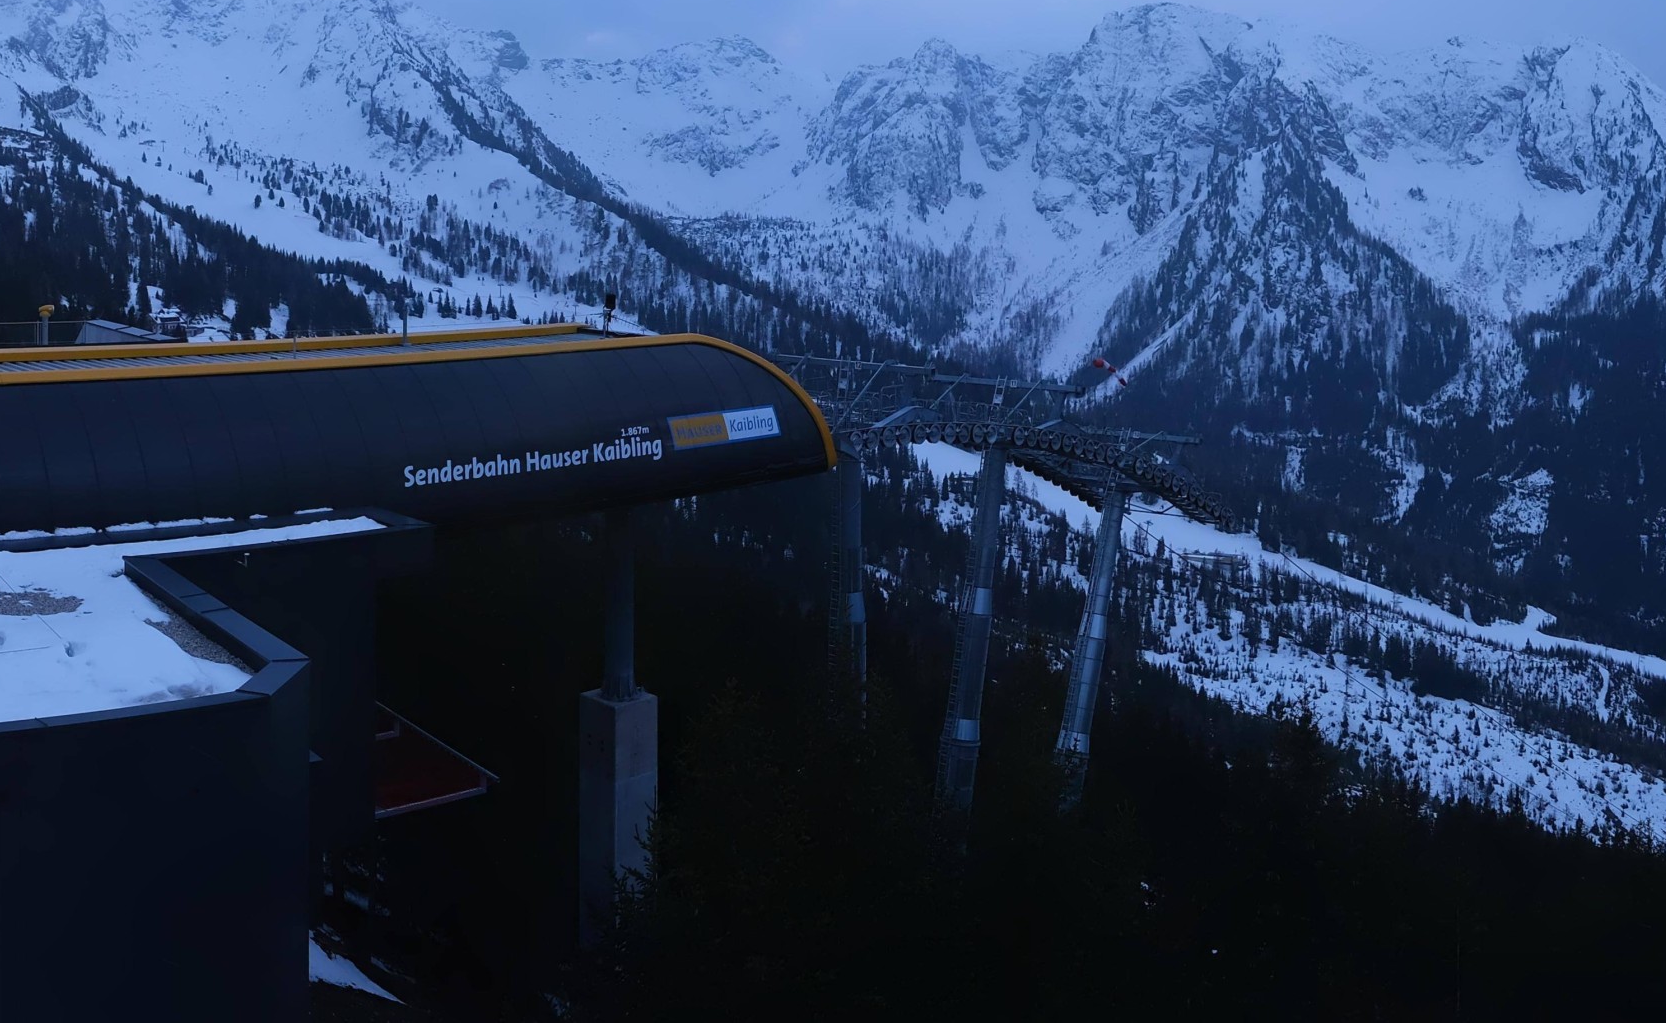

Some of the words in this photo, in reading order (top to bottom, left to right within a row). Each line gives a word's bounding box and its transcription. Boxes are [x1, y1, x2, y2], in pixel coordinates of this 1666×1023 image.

[620, 425, 650, 437] 1.867m
[729, 416, 774, 432] Kaibling
[403, 453, 521, 488] Senderbahn
[525, 447, 589, 473] Hauser
[592, 436, 663, 463] Kaibling
